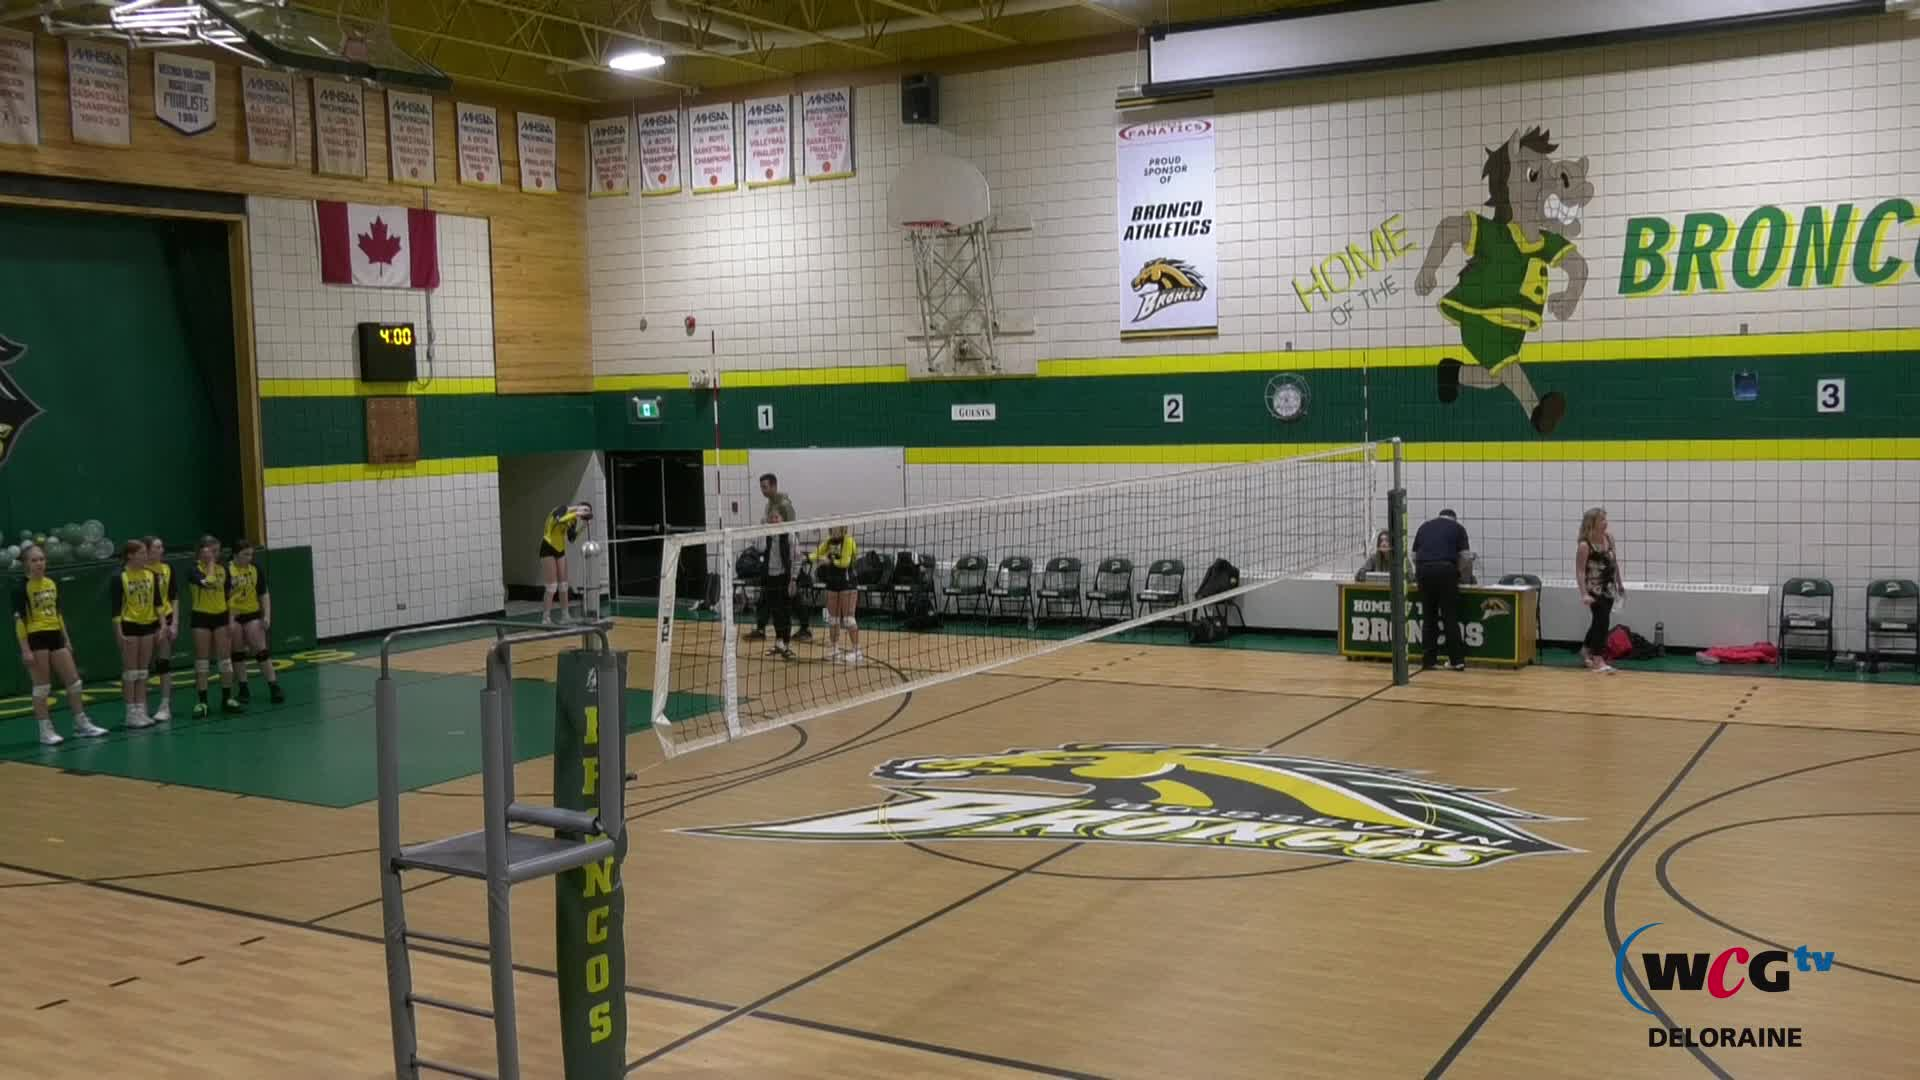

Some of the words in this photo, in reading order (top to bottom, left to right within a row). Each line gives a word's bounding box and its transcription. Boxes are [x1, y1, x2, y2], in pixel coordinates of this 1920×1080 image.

[807, 91, 847, 106] MHSAA
[694, 111, 729, 126] MHSAA
[748, 103, 785, 117] MHSAA
[1127, 123, 1203, 138] FANATICS
[1144, 164, 1188, 177] SPONSOR
[1149, 155, 1182, 166] PROUD
[1159, 175, 1172, 185] OF
[1131, 200, 1203, 222] BRONCO
[1123, 218, 1212, 241] ATHLETICS
[1618, 197, 1920, 297] BRONC
[1291, 213, 1418, 314] HOME
[1132, 290, 1201, 322] BRONCOS
[1330, 303, 1356, 326] OF
[1357, 275, 1400, 310] THE
[1821, 383, 1840, 409] 3
[762, 407, 770, 427] 1
[1167, 398, 1181, 419] 2
[1353, 600, 1392, 613] HOME
[690, 787, 1502, 867] BRONCOS
